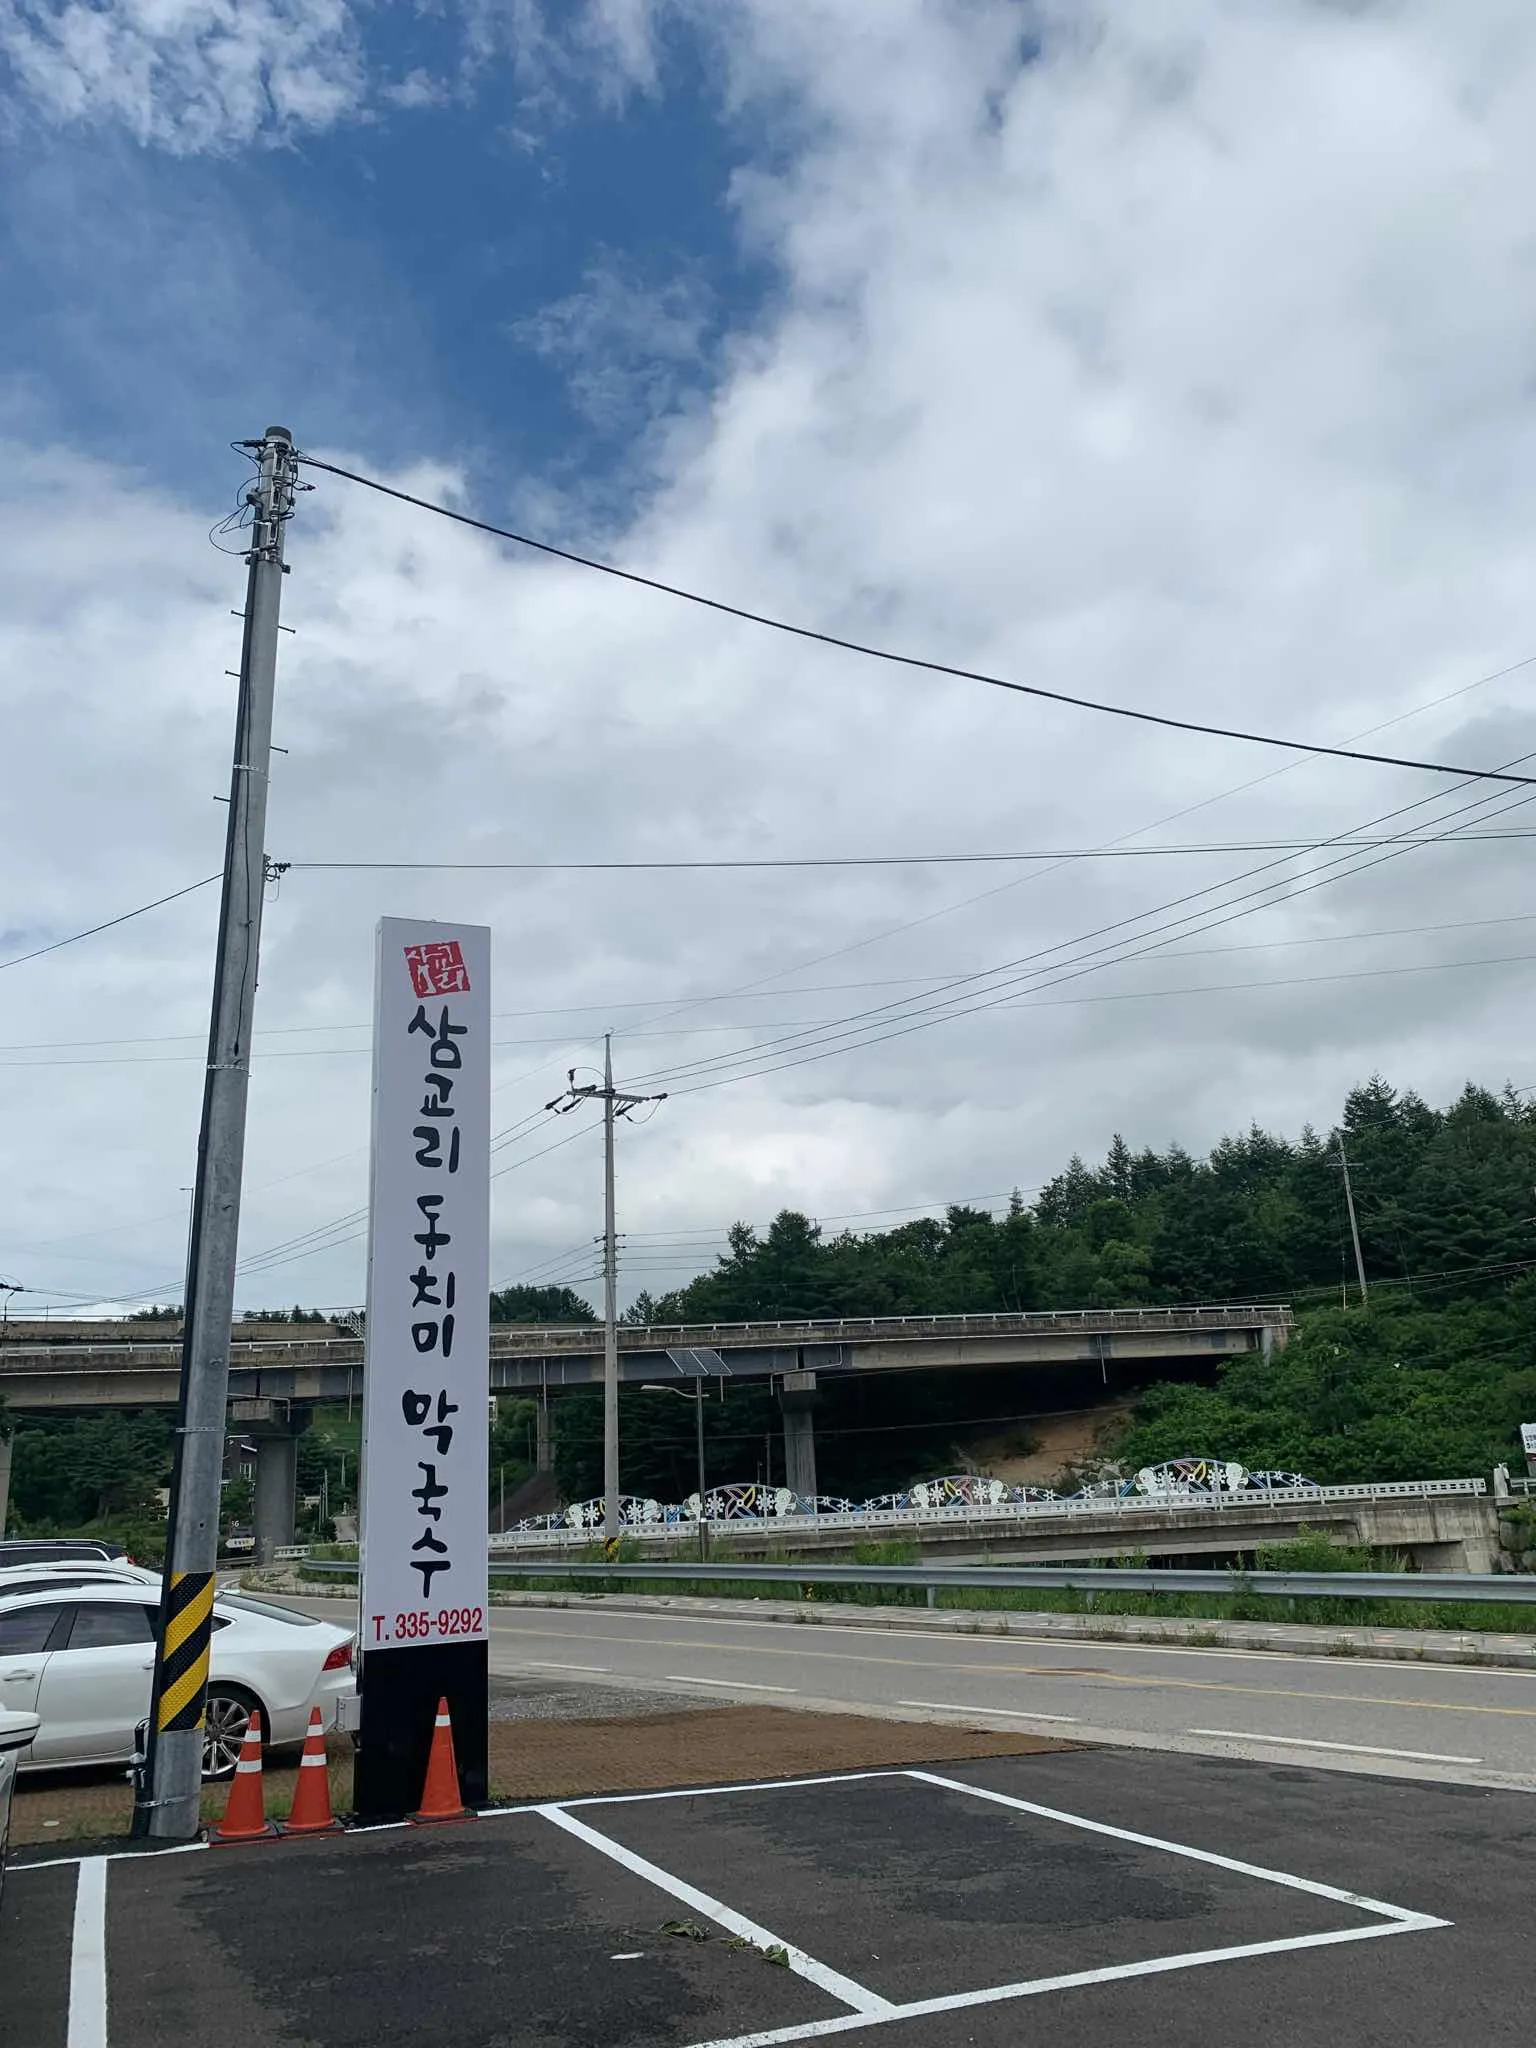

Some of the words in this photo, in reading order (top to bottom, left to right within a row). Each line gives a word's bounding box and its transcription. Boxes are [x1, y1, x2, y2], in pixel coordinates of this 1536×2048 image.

[407, 1004, 468, 1174] 삼교리
[409, 1194, 456, 1358] 동치미
[401, 1388, 459, 1599] 막국수
